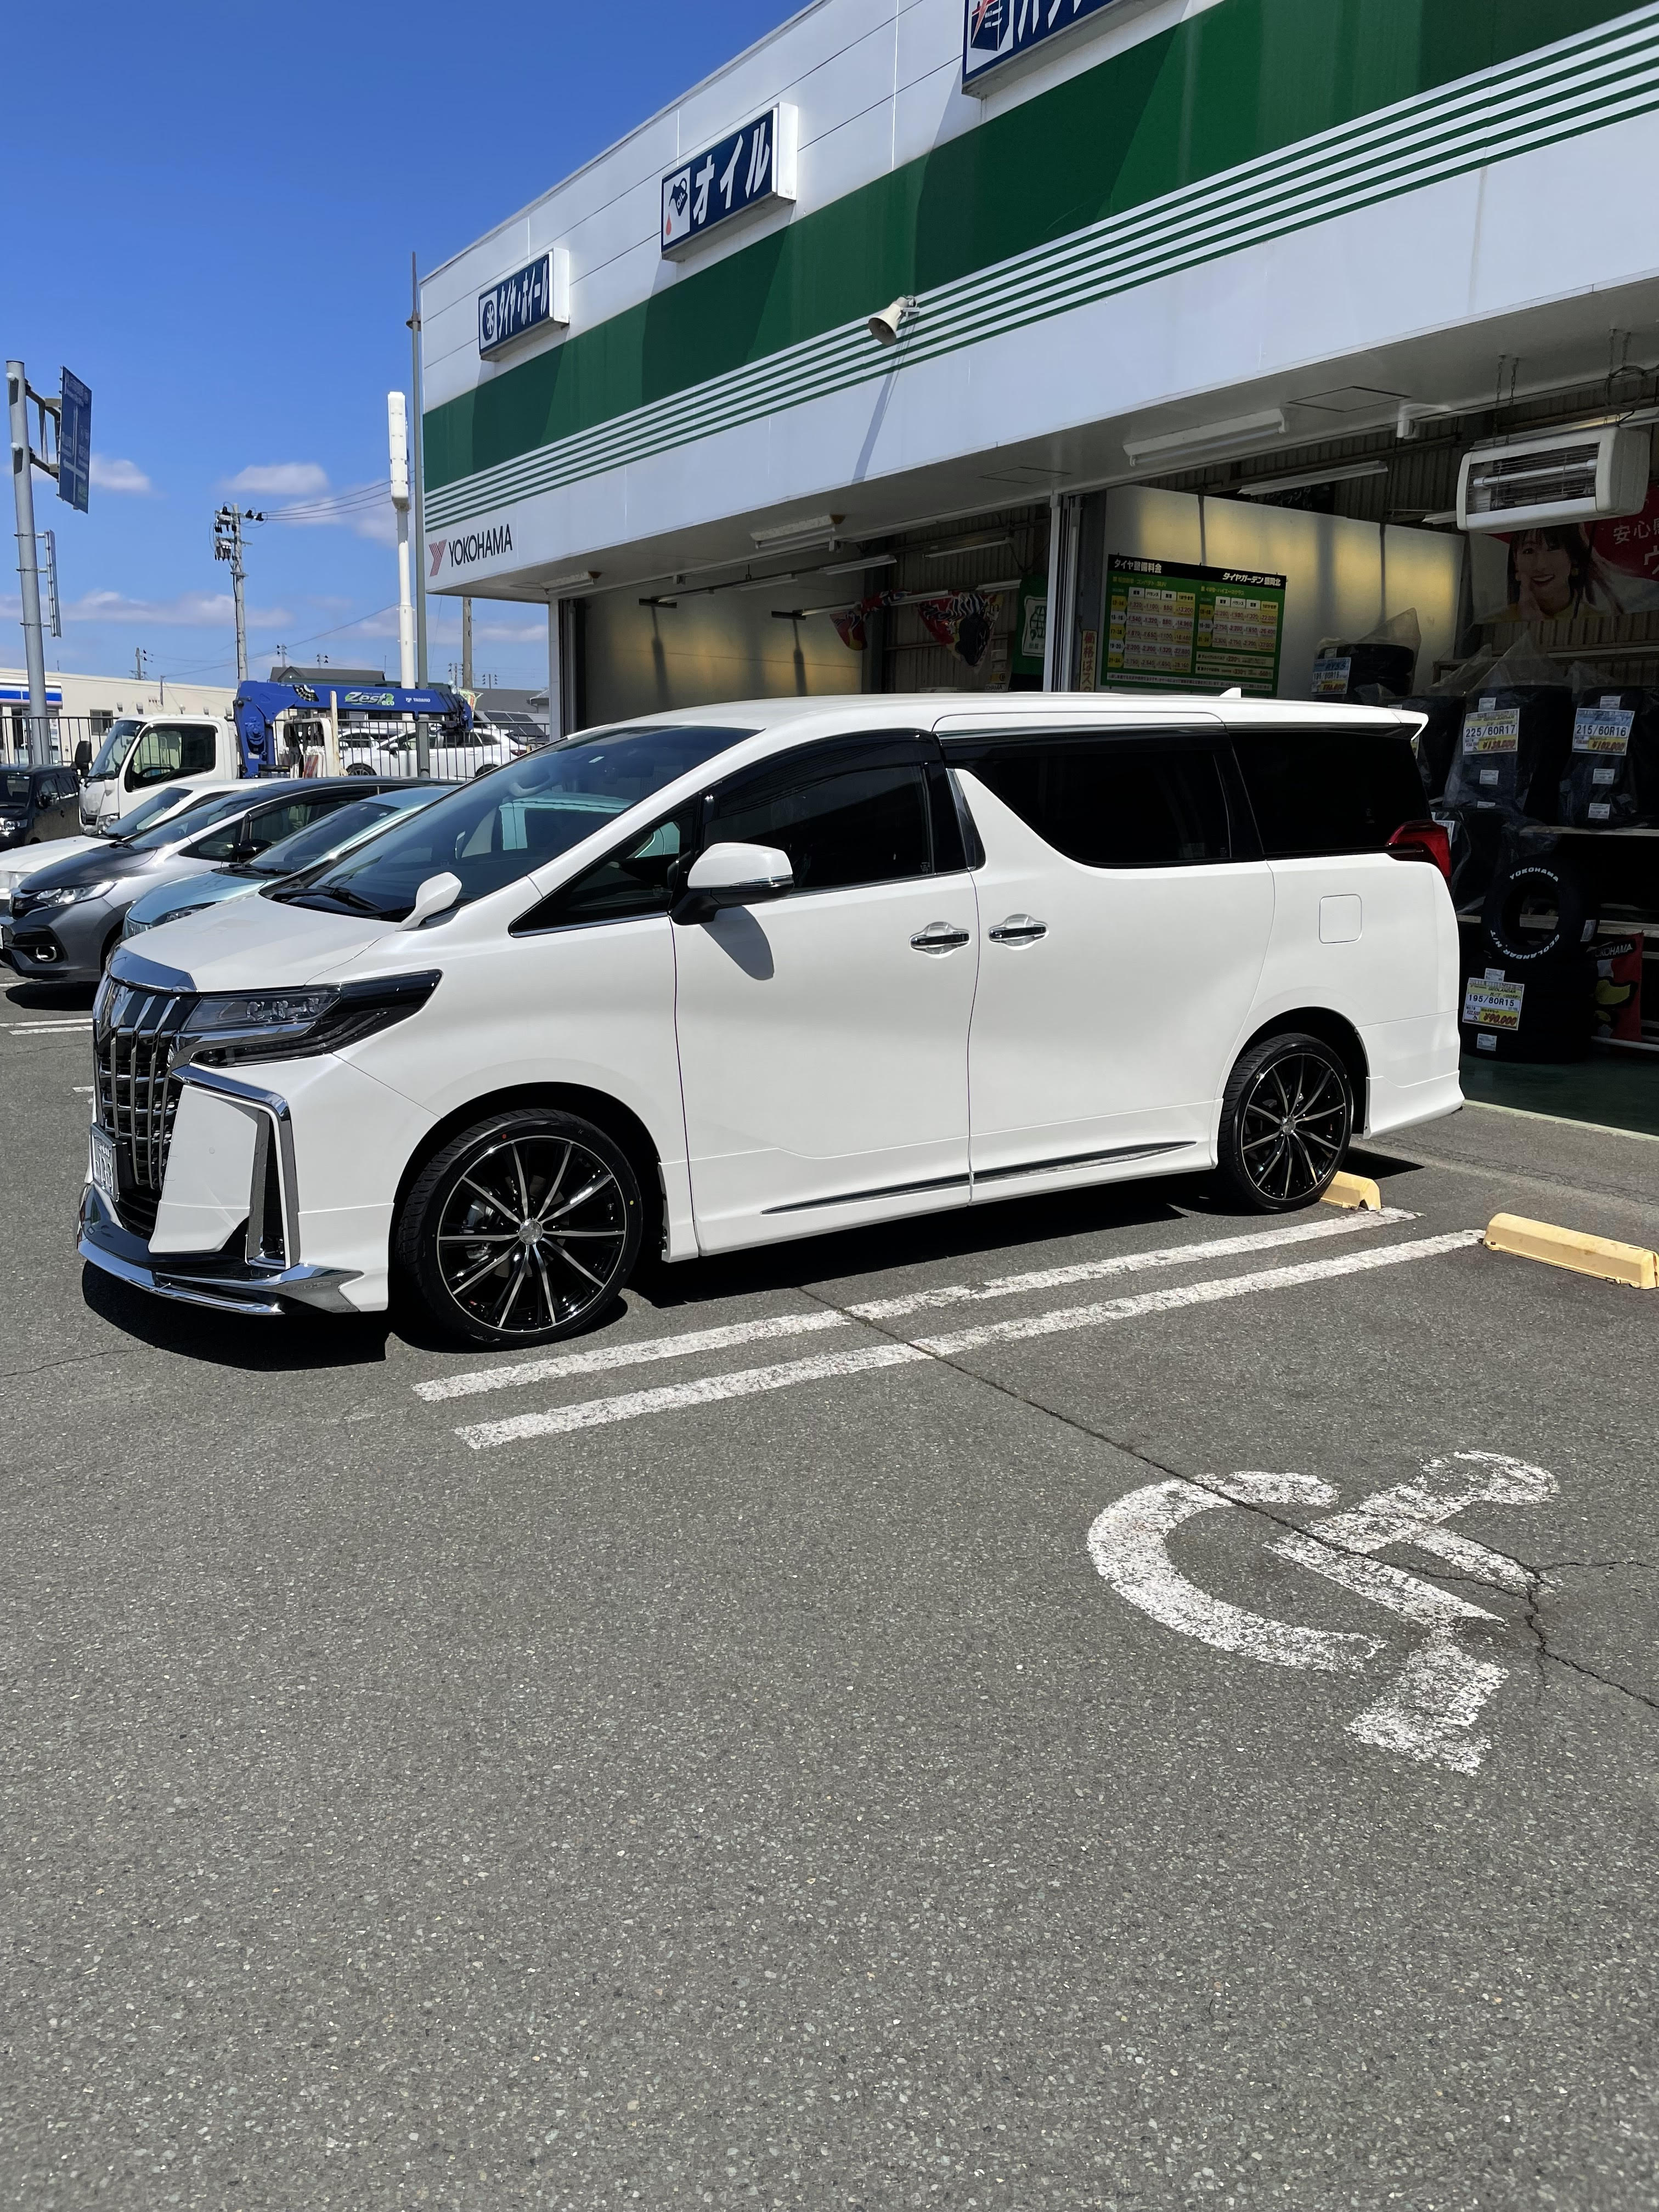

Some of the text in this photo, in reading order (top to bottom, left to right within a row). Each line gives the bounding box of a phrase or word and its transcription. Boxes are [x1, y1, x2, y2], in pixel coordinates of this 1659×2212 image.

[693, 121, 770, 225] オイル
[676, 192, 685, 210] OIL
[499, 259, 548, 339] タイヤ・ホイール
[449, 523, 512, 567] YOKOHAMA
[1222, 572, 1263, 584] タイヤガーデン
[1466, 725, 1515, 738] 225/60R17
[1577, 725, 1627, 736] 215/60R16
[1510, 866, 1559, 882] YOKOHAMA
[1595, 943, 1633, 957] OKOHAMA
[1469, 994, 1514, 1007] 195/80R15
[1483, 1012, 1517, 1025] ¥90,000
